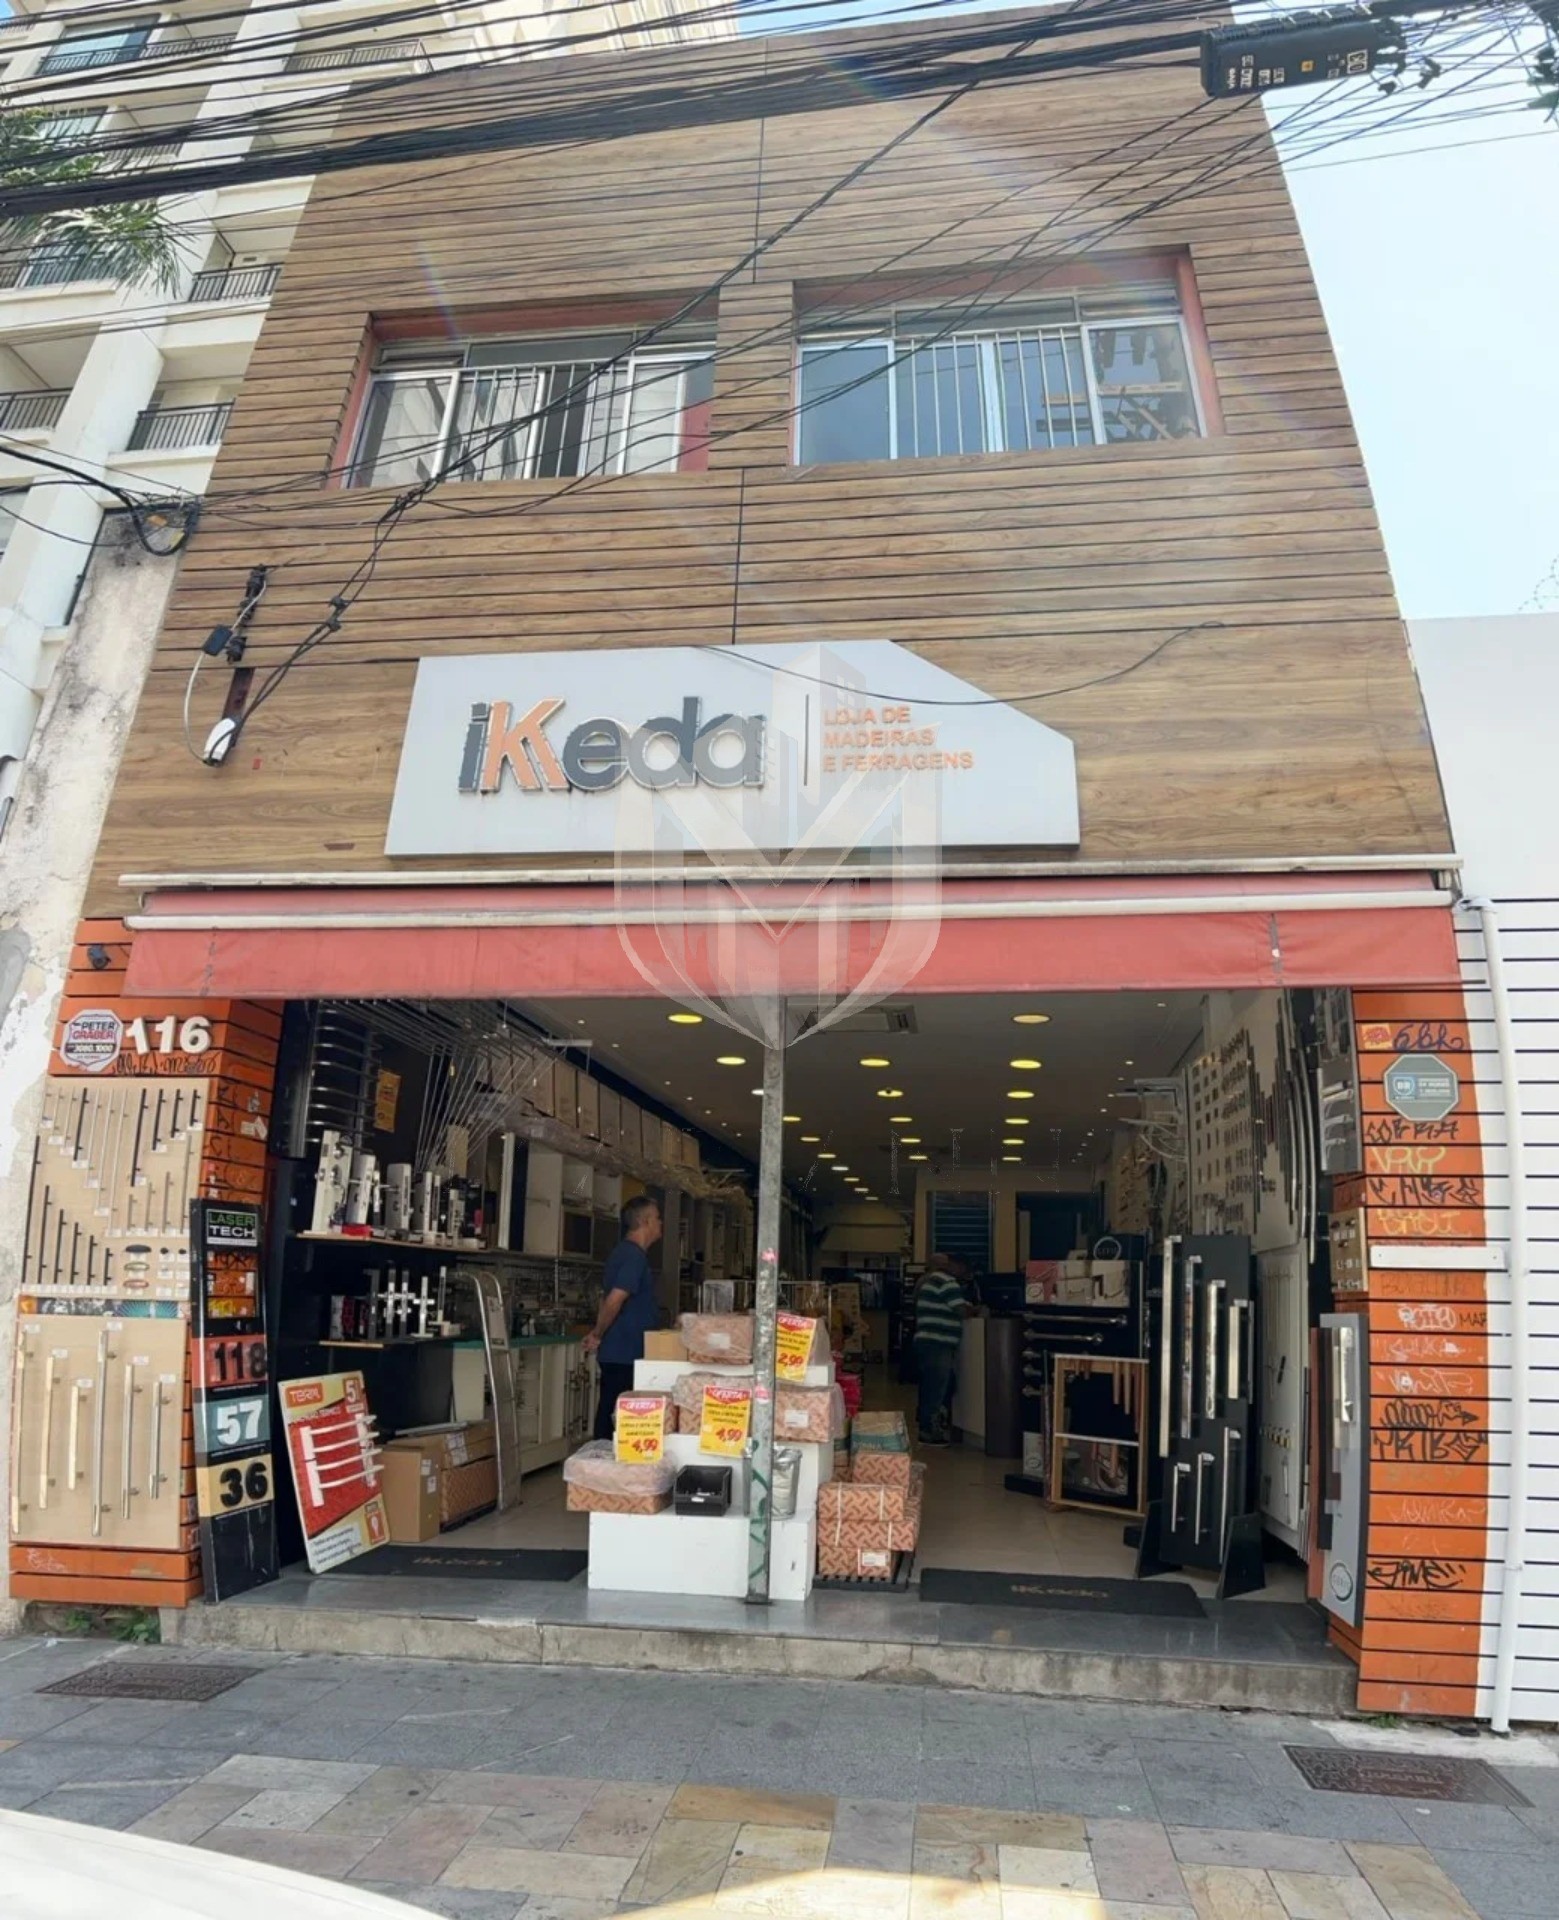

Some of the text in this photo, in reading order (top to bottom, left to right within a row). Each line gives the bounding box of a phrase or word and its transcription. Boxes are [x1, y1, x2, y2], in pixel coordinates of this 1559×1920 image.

[823, 706, 911, 727] LOJA DE
[458, 696, 765, 793] iKeda
[823, 728, 935, 749] MADEIRAS
[823, 751, 974, 773] E FERRAGENS
[81, 1021, 115, 1031] PETER
[126, 1015, 212, 1055] 116
[208, 1213, 256, 1226] LASER
[209, 1225, 256, 1238] TECH
[213, 1341, 268, 1382] 118
[216, 1399, 263, 1446] 57
[219, 1461, 269, 1508] 36
